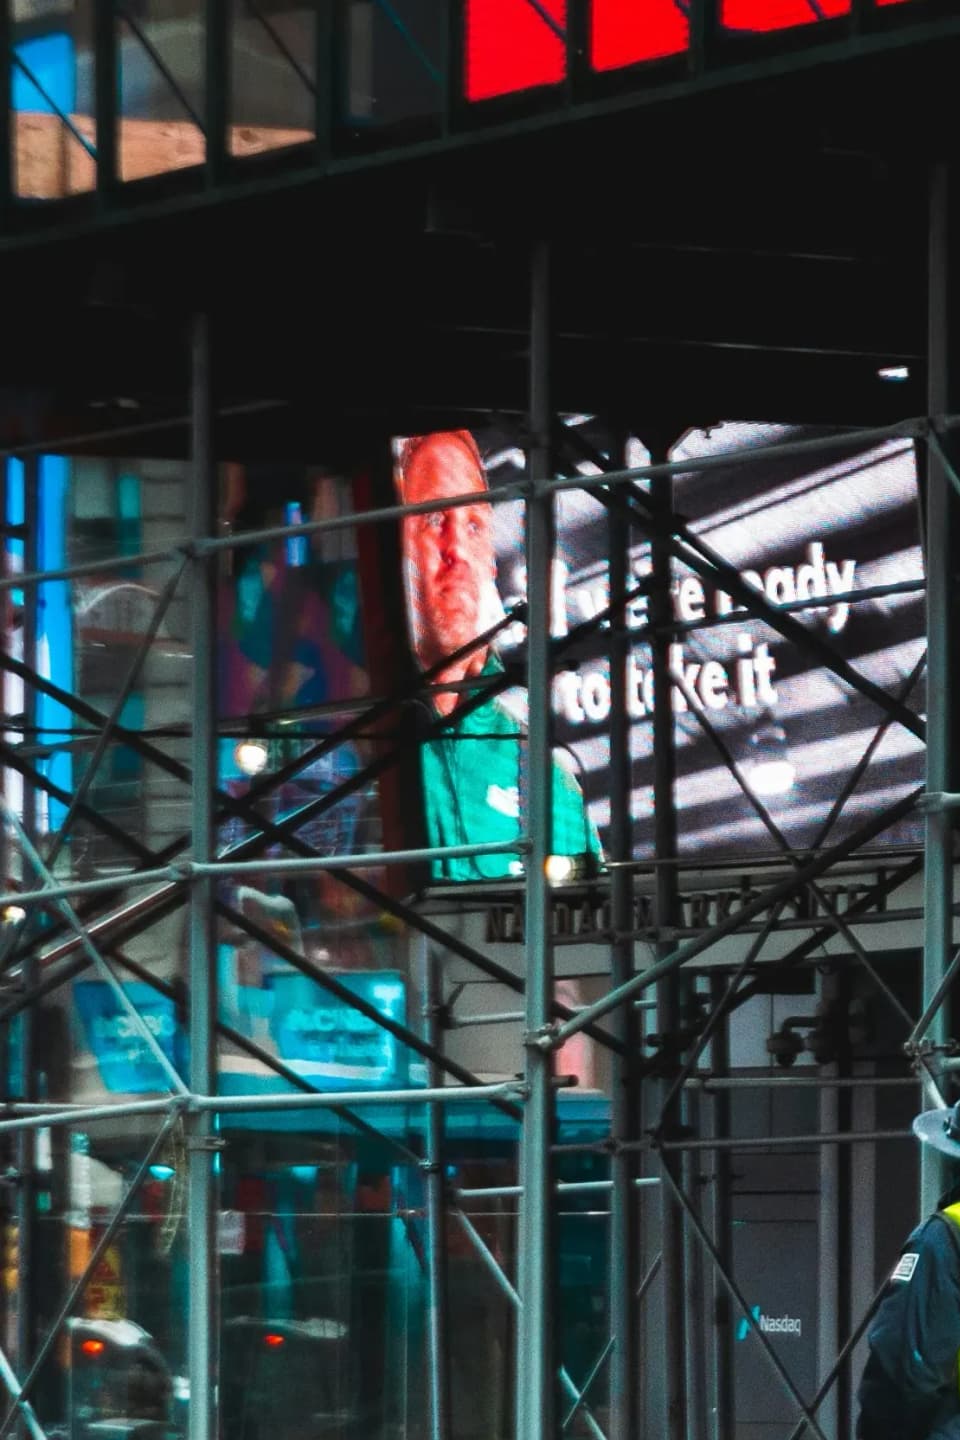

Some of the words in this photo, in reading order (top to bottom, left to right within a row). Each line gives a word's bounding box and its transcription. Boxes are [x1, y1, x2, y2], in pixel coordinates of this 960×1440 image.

[552, 666, 612, 725] to
[737, 632, 779, 708] it
[760, 1313, 802, 1337] Nasdaq
